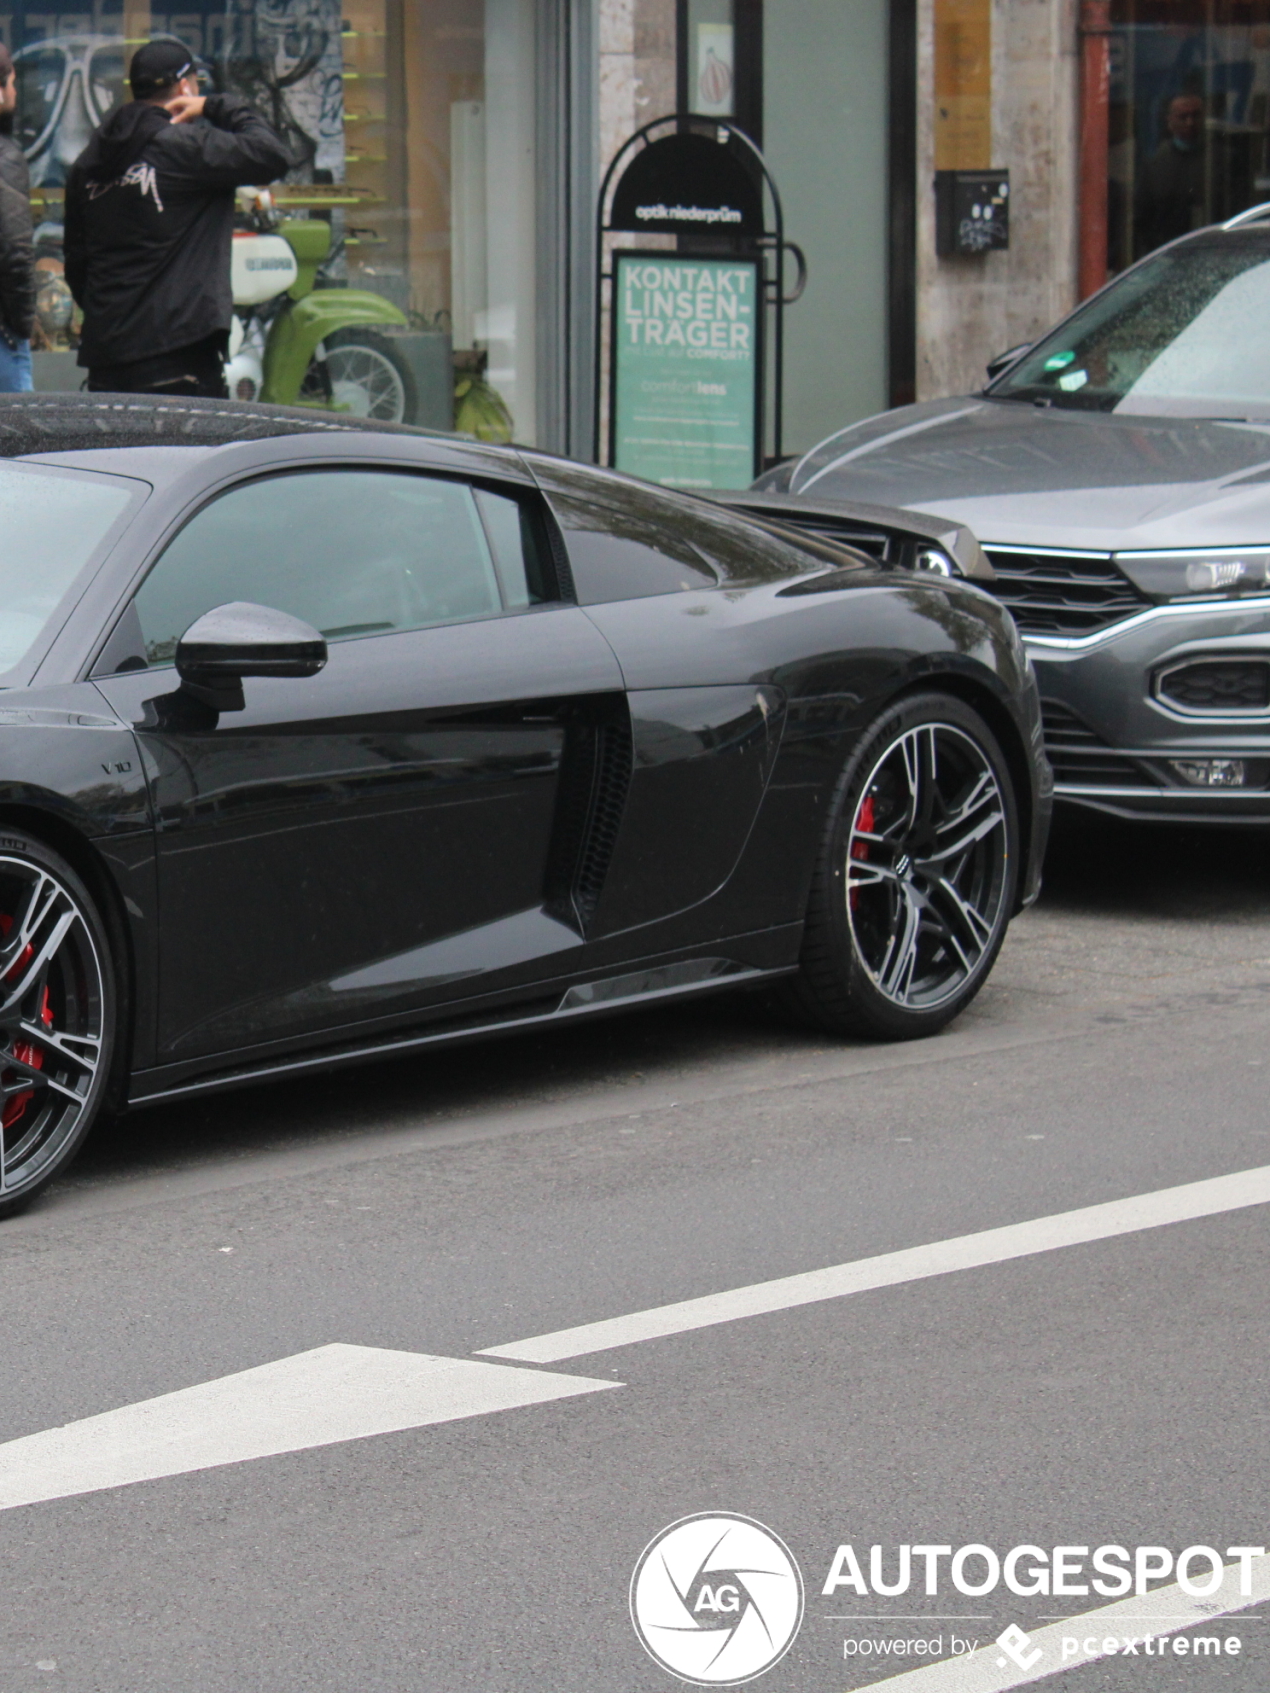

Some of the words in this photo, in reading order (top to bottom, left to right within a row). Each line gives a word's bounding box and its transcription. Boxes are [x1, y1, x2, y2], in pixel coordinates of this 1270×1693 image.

[635, 203, 668, 221] optik
[669, 204, 742, 224] niederprüm
[625, 266, 751, 294] KONTAKT
[625, 289, 751, 321] LINSEN-
[625, 317, 750, 349] TRÄGER
[686, 349, 750, 361] COMFORT?
[101, 761, 132, 775] V10
